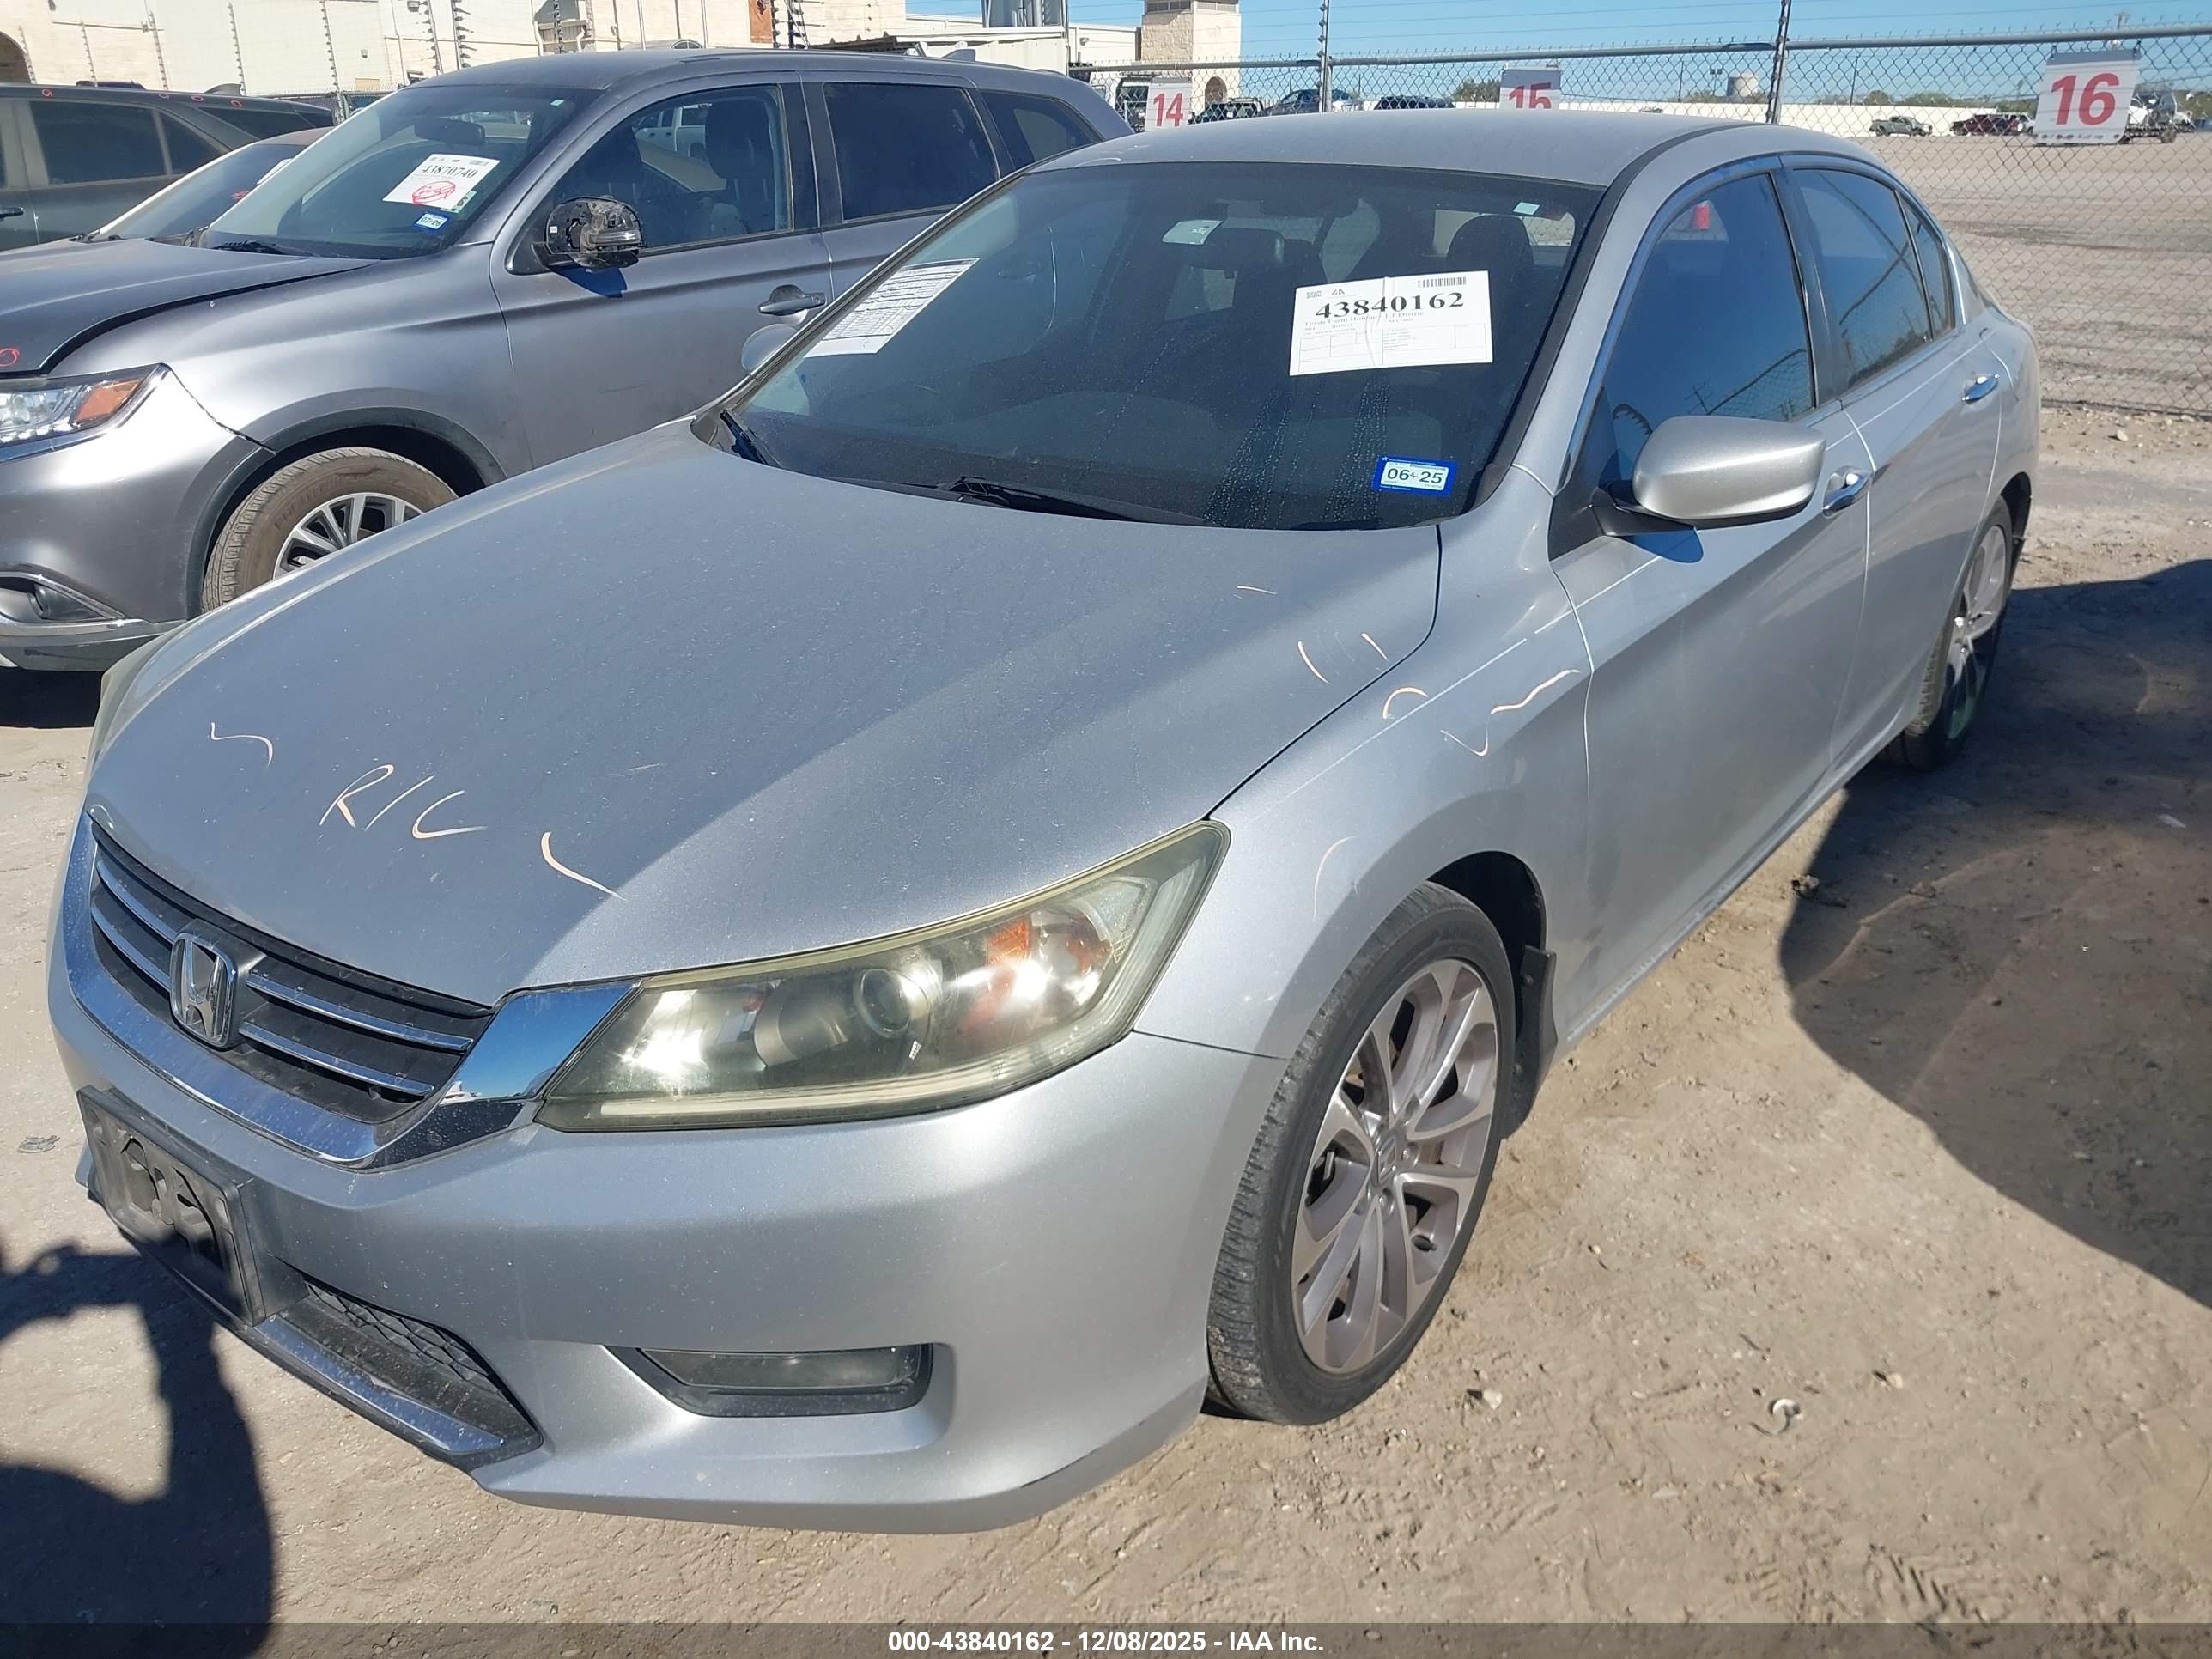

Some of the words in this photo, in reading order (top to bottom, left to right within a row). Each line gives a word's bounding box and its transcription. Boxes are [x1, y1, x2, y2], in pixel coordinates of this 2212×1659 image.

[1509, 82, 1552, 109] 15
[2051, 74, 2119, 125] 16
[1153, 92, 1183, 127] 14
[422, 163, 480, 179] 43870740
[1316, 293, 1464, 318] 43840162
